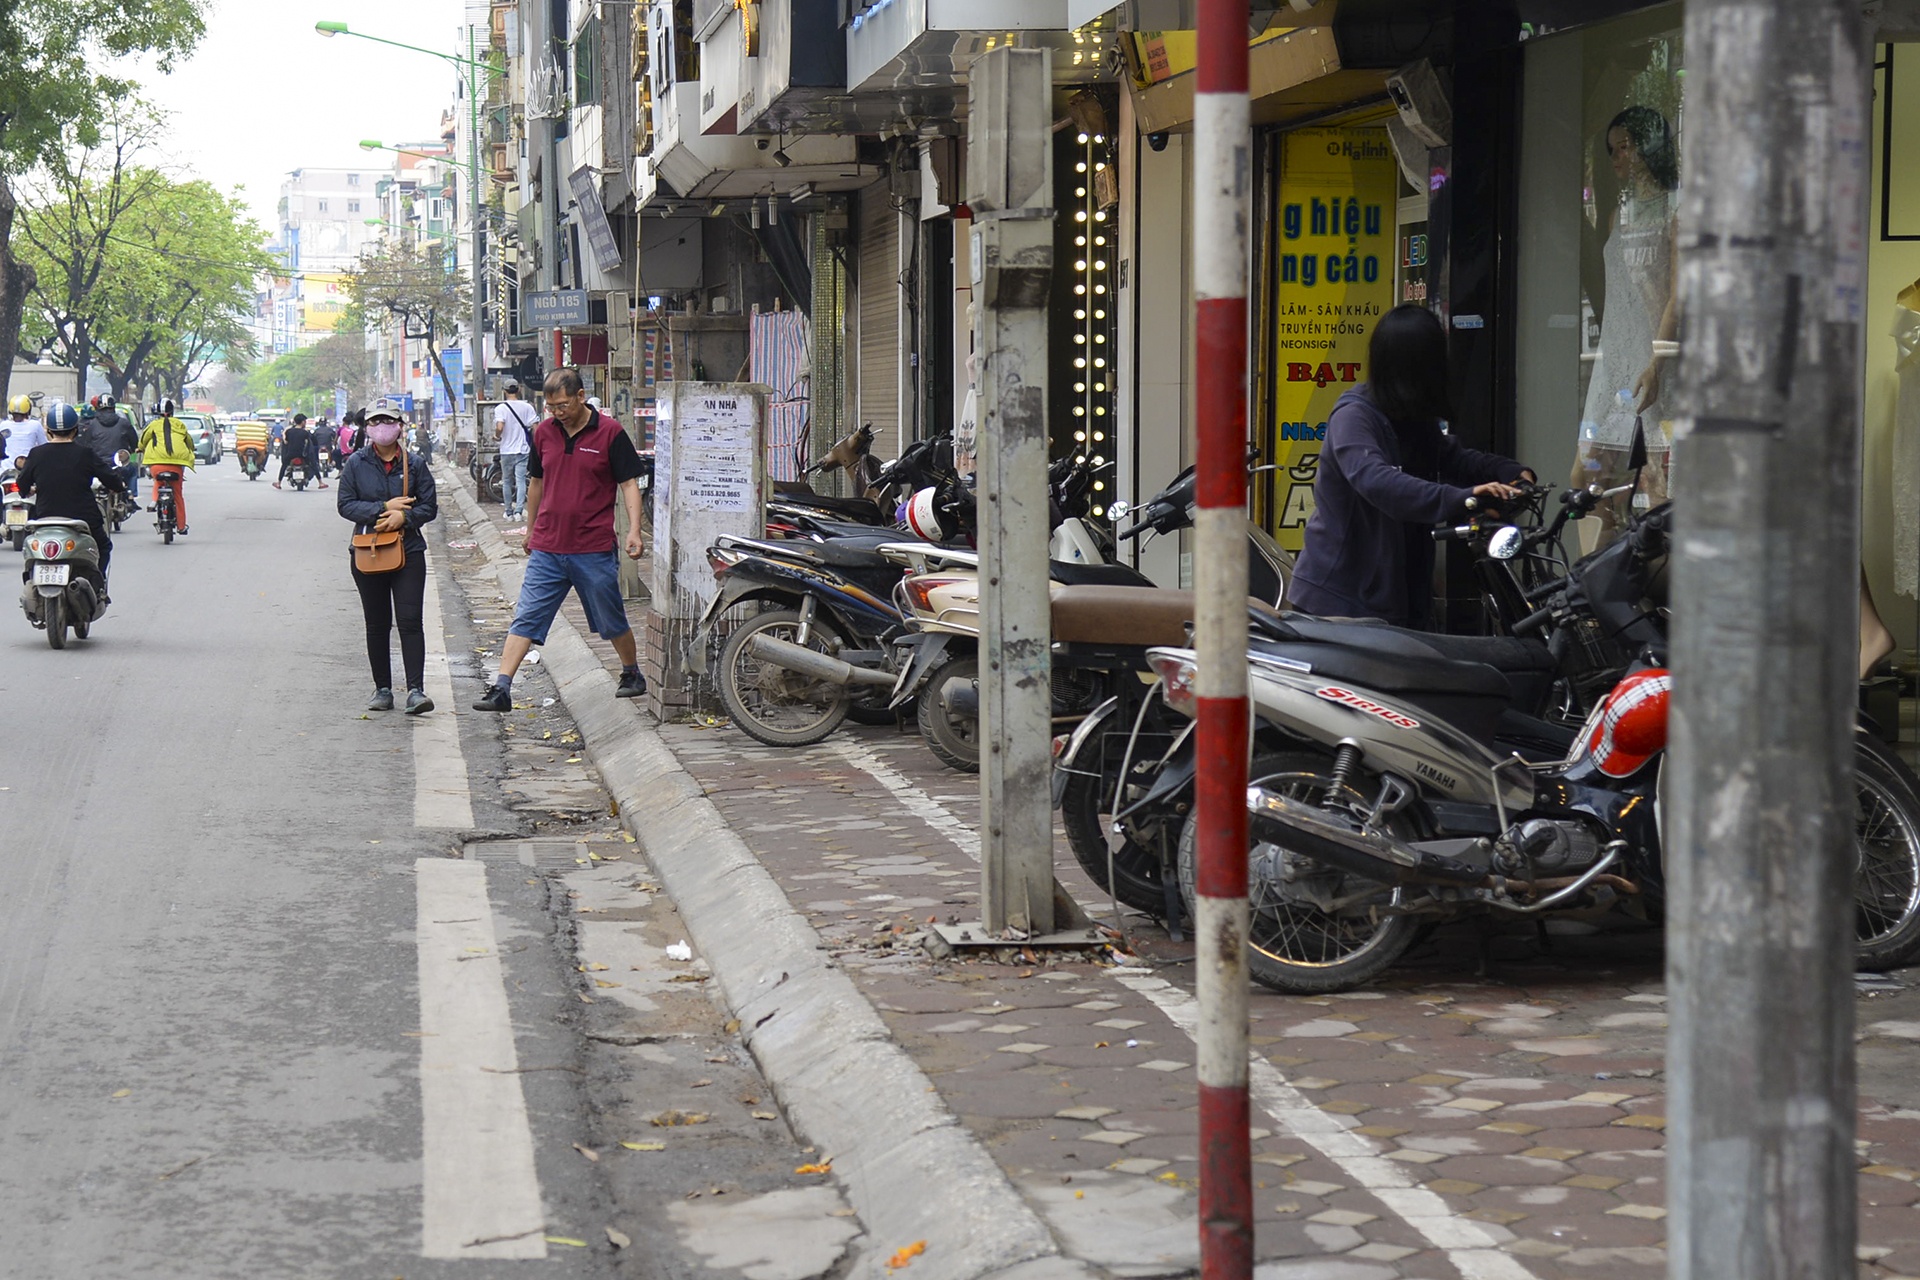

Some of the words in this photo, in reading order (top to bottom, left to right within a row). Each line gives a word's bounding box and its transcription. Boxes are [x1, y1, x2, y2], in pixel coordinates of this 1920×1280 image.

[1310, 196, 1381, 244] hiệu
[1402, 234, 1428, 269] LED
[1325, 247, 1379, 284] cáo
[560, 295, 580, 307] 185
[1317, 302, 1342, 316] SÂN
[1346, 301, 1380, 316] KHẤU
[551, 312, 565, 320] KIM
[1325, 319, 1365, 335] THỐNG
[1281, 340, 1336, 349] NEONSIGN
[1286, 362, 1361, 388] BẠT
[1416, 761, 1456, 790] YAMAHA
